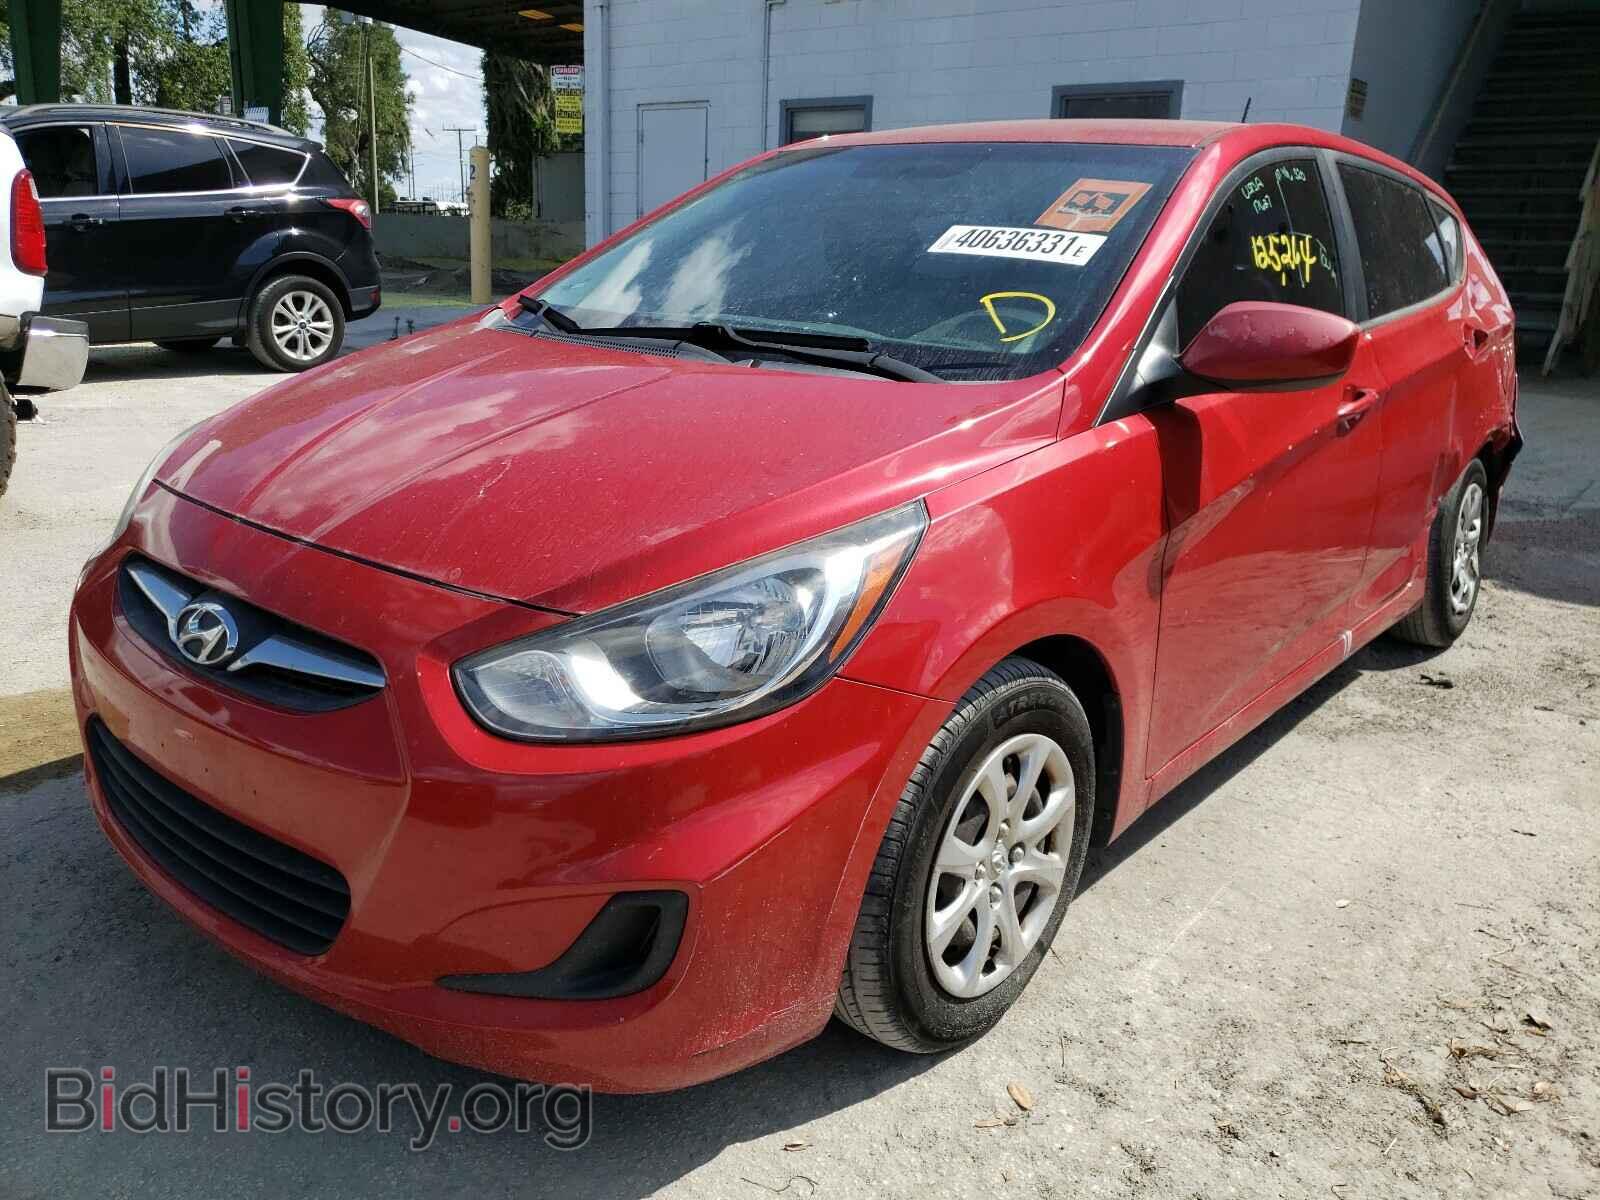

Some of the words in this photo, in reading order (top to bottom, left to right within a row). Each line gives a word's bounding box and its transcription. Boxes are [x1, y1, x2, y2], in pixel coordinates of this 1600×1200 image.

[956, 228, 1075, 256] 40636331
[1074, 245, 1088, 258] E
[979, 291, 1056, 342] D
